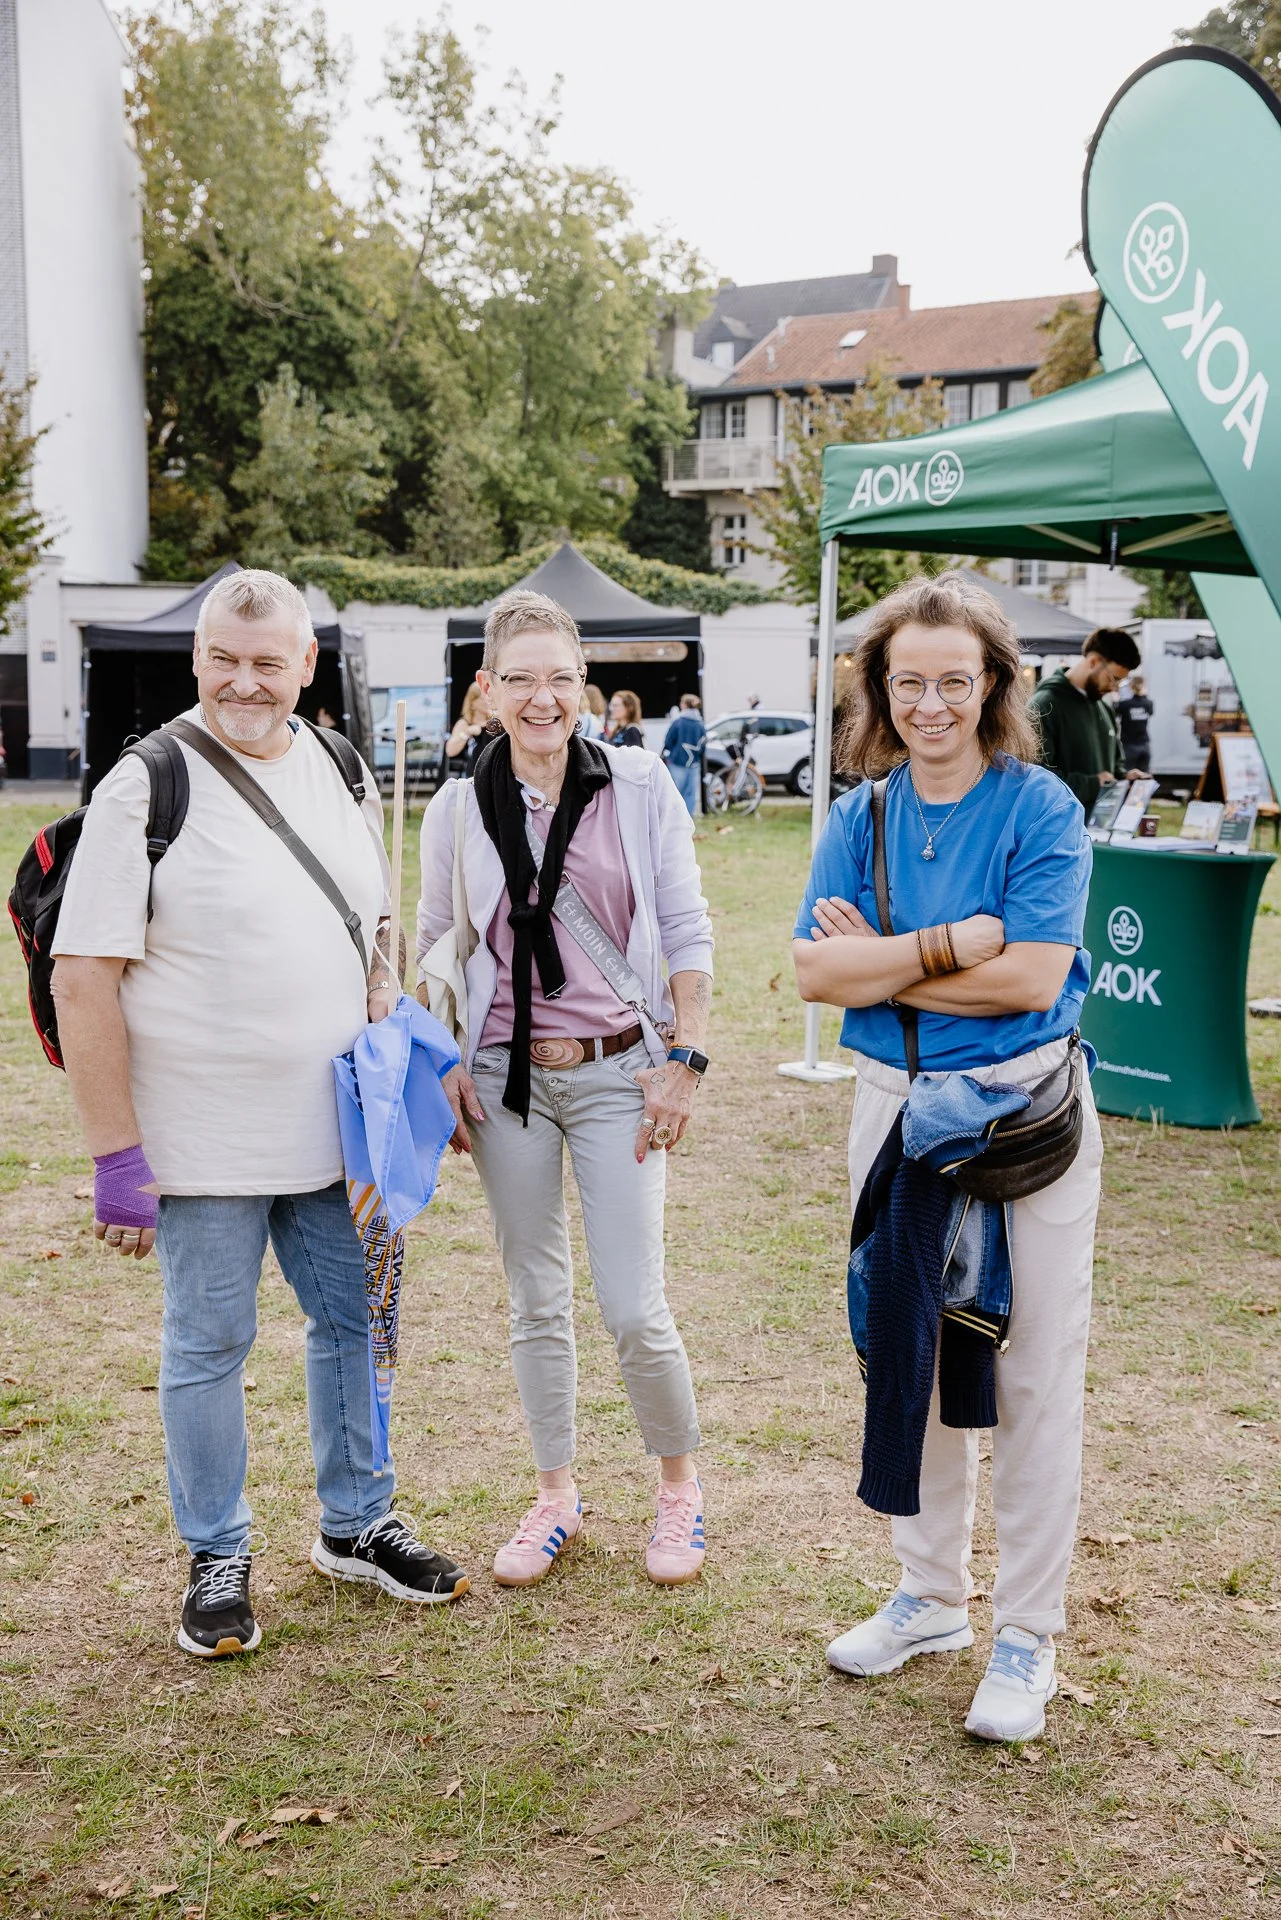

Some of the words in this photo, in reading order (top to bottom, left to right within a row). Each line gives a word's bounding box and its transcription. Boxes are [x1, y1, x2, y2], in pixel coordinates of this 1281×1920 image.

[848, 461, 922, 510] AOK
[573, 916, 607, 956] MOIN
[1091, 961, 1163, 1007] AOK
